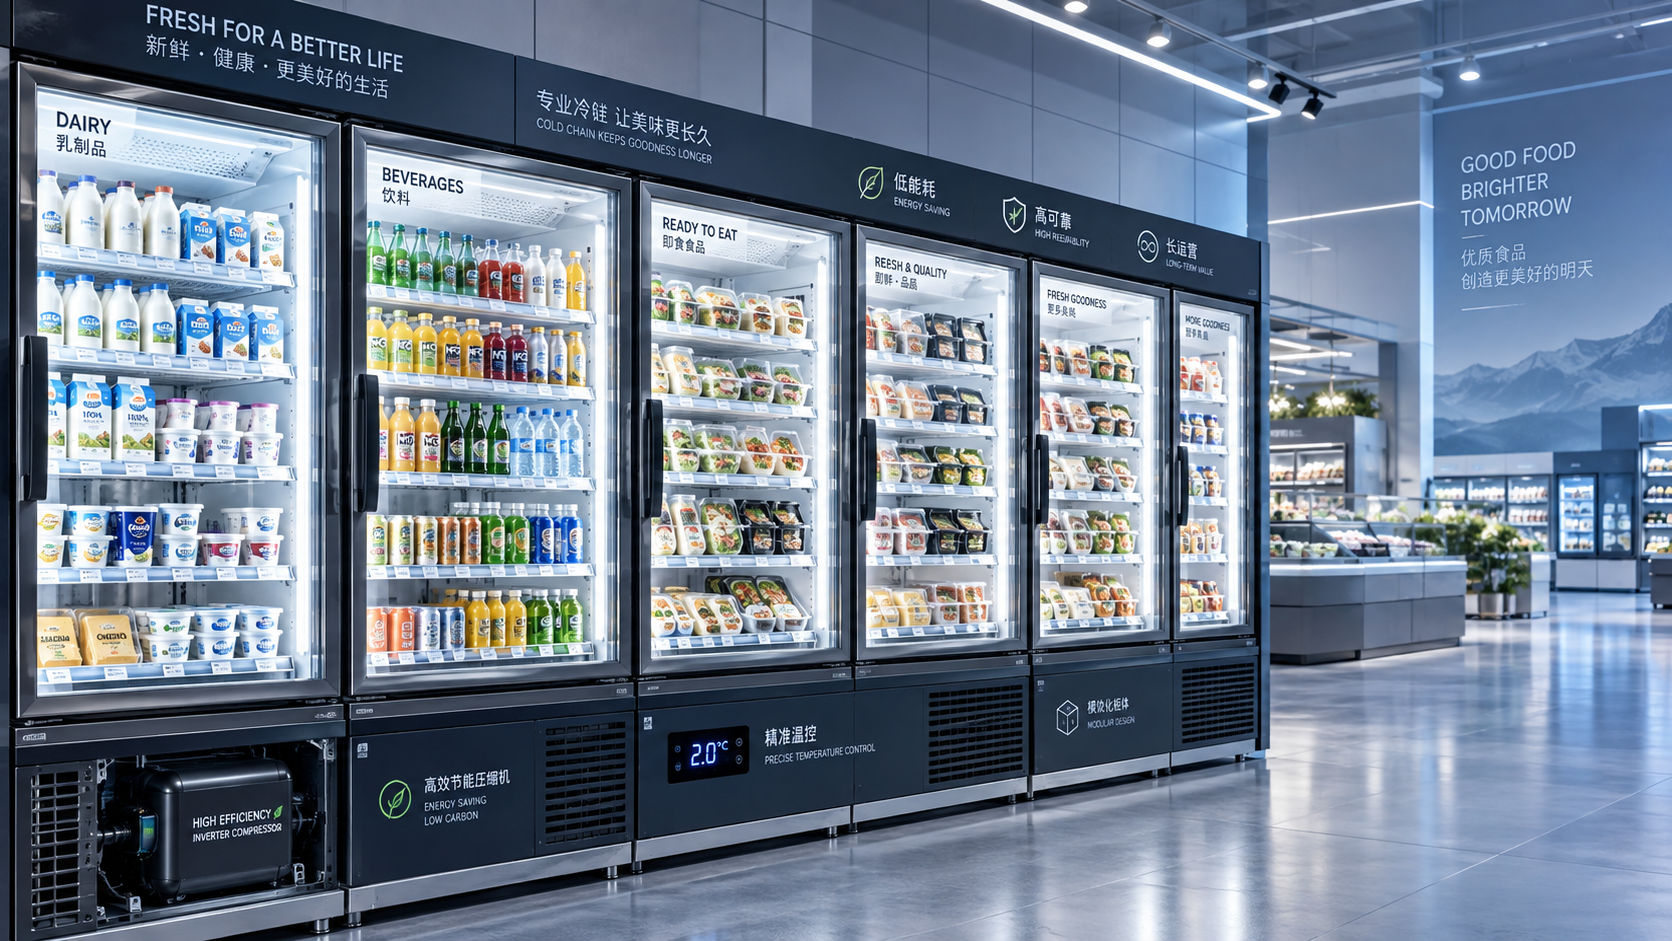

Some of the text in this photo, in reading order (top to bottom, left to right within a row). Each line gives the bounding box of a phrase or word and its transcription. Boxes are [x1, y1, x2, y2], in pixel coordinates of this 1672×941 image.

[146, 4, 403, 73] FRESH FOR A BETTER LIFE
[56, 112, 111, 136] DAIRY
[537, 118, 712, 164] COLD CHAIN KEEPS GOODNESS LONGER
[1461, 141, 1576, 174] GOOD FOOD
[382, 167, 464, 194] BEVERAGES
[1461, 172, 1549, 201] BRIGHTER
[382, 187, 410, 206] 饮料
[894, 197, 951, 217] ENERGY SAVING
[1461, 195, 1572, 227] TOMORROW
[662, 216, 738, 241] READY TO EAT
[662, 234, 706, 254] 即食食品
[1461, 243, 1527, 268] 优质食品
[905, 262, 912, 273] &
[913, 263, 948, 279] QUALITY
[1461, 259, 1594, 290] 创造更美好的明天
[1047, 289, 1069, 302] FRESH
[764, 743, 876, 765] PRECISE TEMPERATURE CONTROL
[457, 796, 488, 808] SAVING
[192, 809, 272, 829] HIGH EFFICIENCY
[424, 811, 479, 827] LOW CARBON
[192, 823, 283, 843] INVERTER COMPRESSOR
